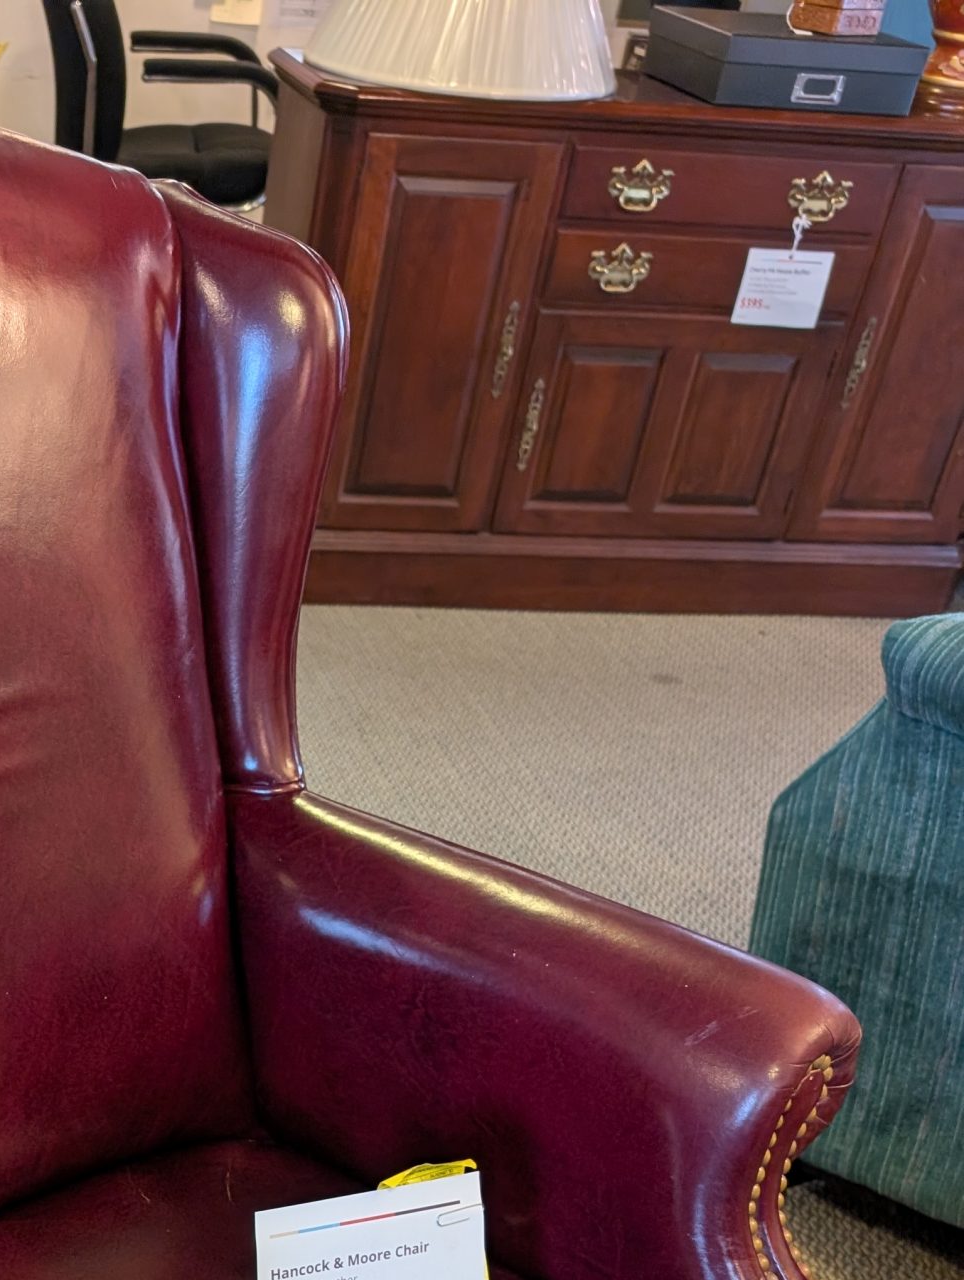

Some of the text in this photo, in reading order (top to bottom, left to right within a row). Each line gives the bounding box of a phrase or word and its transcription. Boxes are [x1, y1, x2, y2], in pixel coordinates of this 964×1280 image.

[270, 1241, 430, 1280] Hancock & Moore Chair
